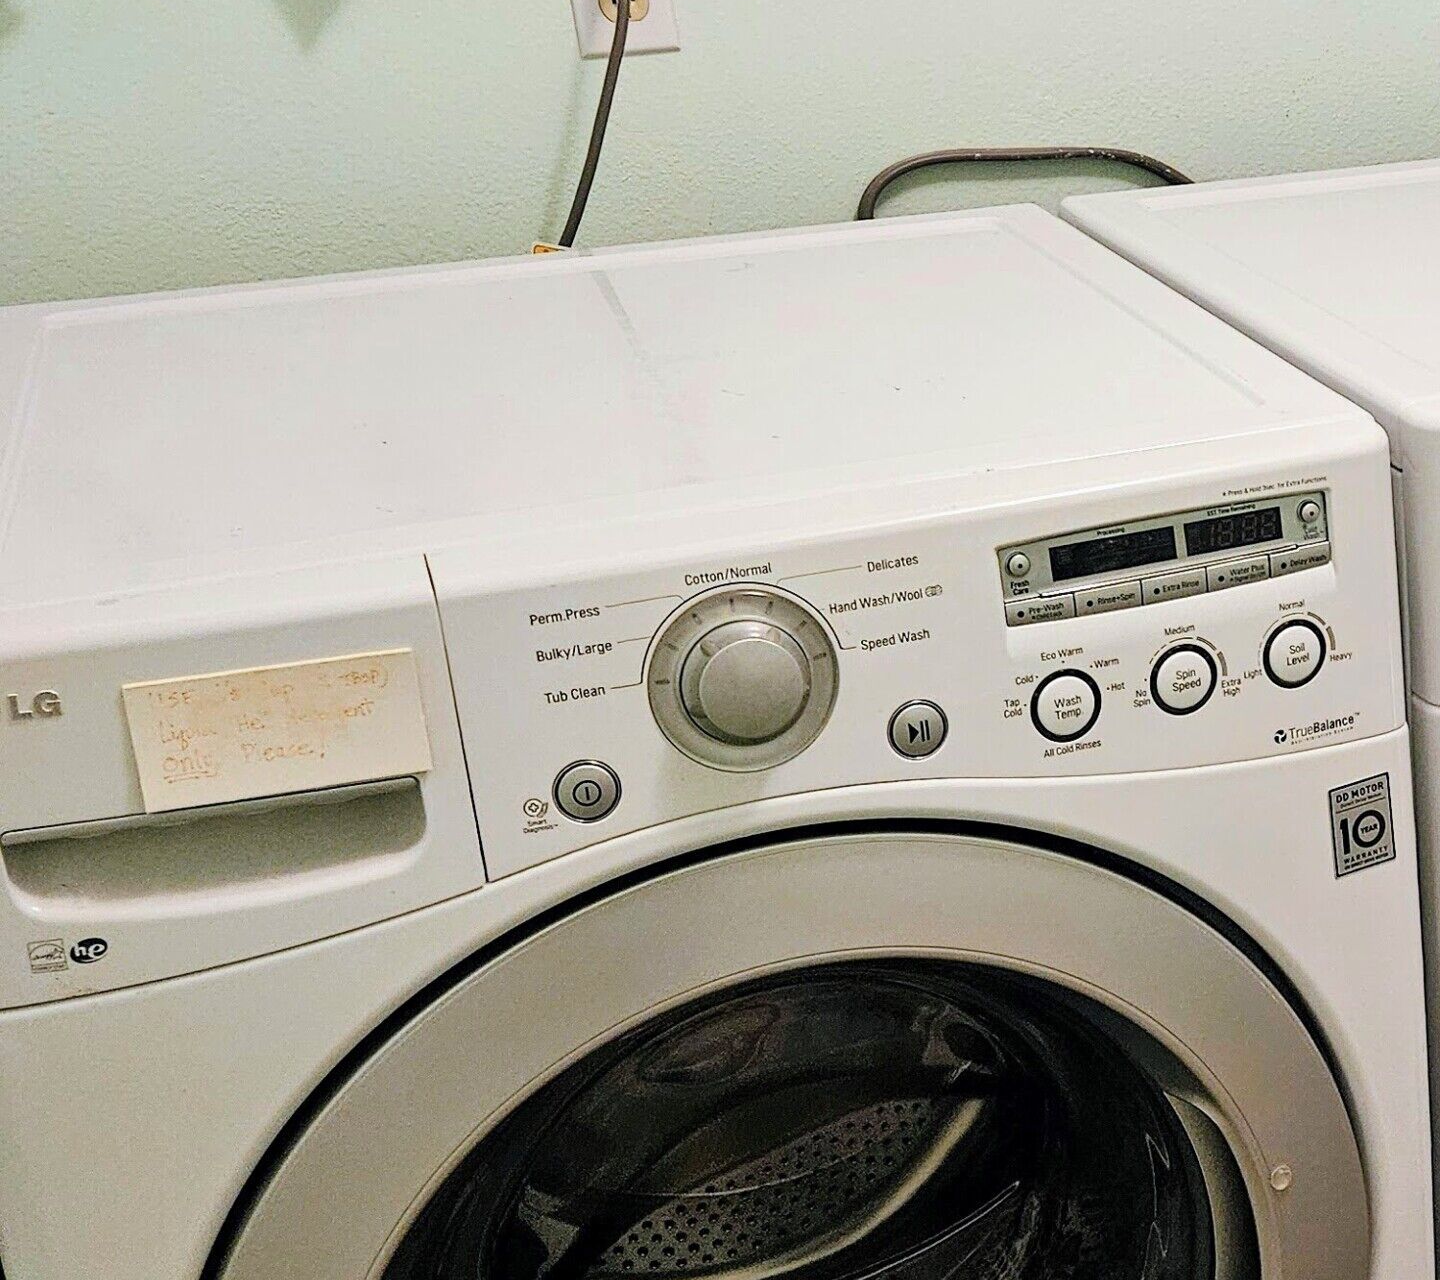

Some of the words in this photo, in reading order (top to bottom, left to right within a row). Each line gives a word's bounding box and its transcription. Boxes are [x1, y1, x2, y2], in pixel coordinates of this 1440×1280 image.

[1097, 526, 1126, 536] Processing
[867, 555, 919, 573] Delicates
[684, 563, 772, 587] Cotton/Normal
[1010, 580, 1030, 589] Fresh
[1162, 582, 1181, 594] Extra
[1181, 580, 1200, 591] Rinse
[1013, 587, 1029, 596] Care
[829, 600, 857, 615] Hand
[859, 589, 924, 610] Wash/Wool
[1098, 592, 1136, 605] Rinse+Spin
[1278, 599, 1306, 611] Normal
[1028, 602, 1065, 615] Pre-Wash
[529, 606, 601, 627] Perm.Press
[1164, 623, 1195, 637] Medium
[860, 634, 896, 653] Speed
[897, 628, 931, 644] Wash
[536, 640, 613, 663] Bulky/Large
[1040, 651, 1057, 661] Eco
[1058, 646, 1084, 658] Warm
[1289, 643, 1306, 654] Soil
[1093, 657, 1120, 669] Warm
[1286, 653, 1310, 666] Level
[1329, 651, 1353, 663] Heavy
[1015, 675, 1034, 686] Cold
[1176, 668, 1197, 683] Spin
[1243, 668, 1263, 681] Light
[1111, 681, 1126, 692] Hot
[1172, 678, 1202, 694] Speed
[1221, 678, 1242, 689] Extra
[544, 692, 568, 706] Tub
[570, 685, 606, 701] Clean
[1135, 690, 1148, 698] No
[1223, 687, 1241, 698] High
[7, 690, 63, 719] LG
[1004, 698, 1021, 710] Tap
[1054, 695, 1083, 708] Wash
[1133, 698, 1151, 709] Spin
[1003, 707, 1024, 719] Cold
[1043, 749, 1055, 758] All
[1056, 745, 1074, 757] Cold
[1075, 739, 1102, 754] Rinses
[1336, 793, 1349, 803] DD
[1351, 781, 1384, 797] MOTOR
[1340, 809, 1386, 855] 10
[1360, 824, 1378, 834] YEAR
[1343, 845, 1388, 864] WARRANTY
[72, 939, 106, 963] he
